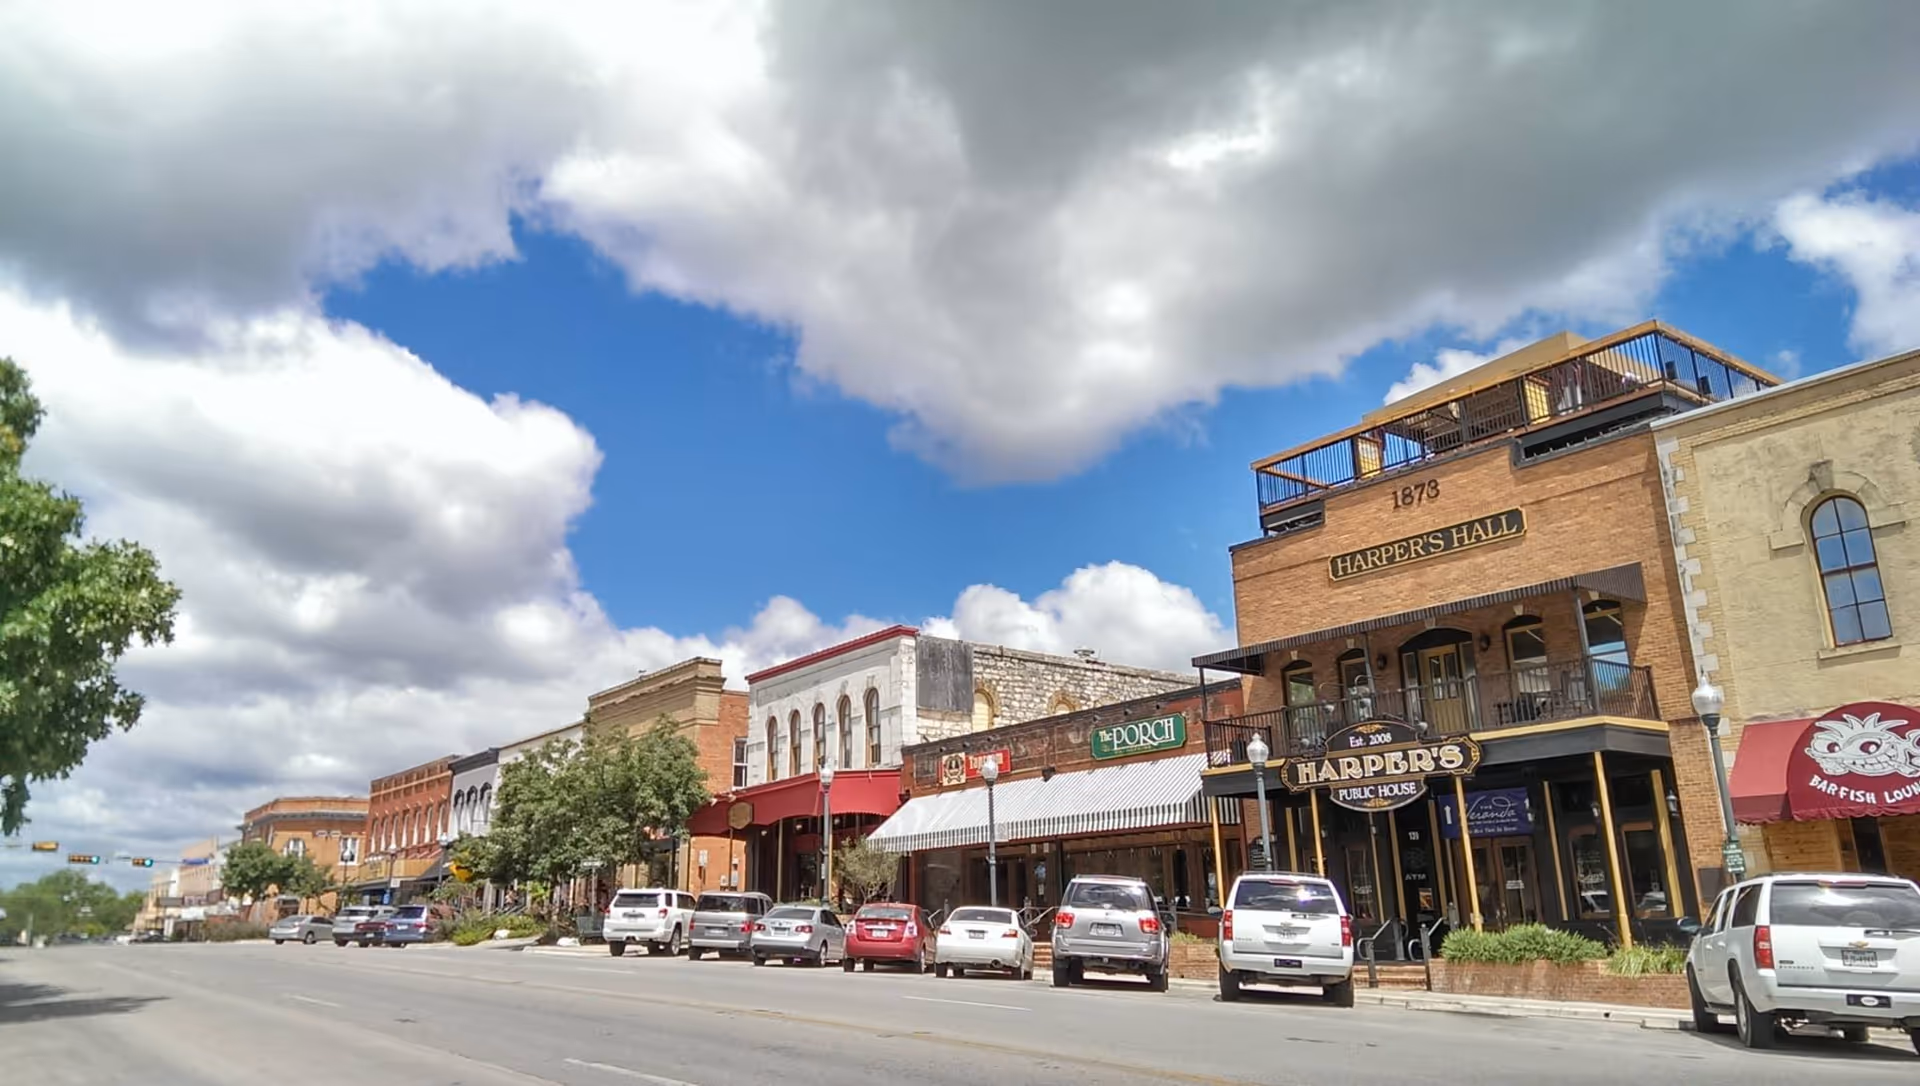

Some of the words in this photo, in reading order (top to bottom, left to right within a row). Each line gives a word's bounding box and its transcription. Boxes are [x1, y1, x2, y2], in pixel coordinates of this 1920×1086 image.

[1335, 532, 1445, 577] HARPER'S
[1451, 514, 1518, 548] HALL
[1098, 729, 1113, 742] The
[1112, 718, 1176, 750] PORCH
[1350, 736, 1367, 748] Est.
[1369, 732, 1392, 745] 2008
[1297, 745, 1464, 784] HARPER'S
[1338, 785, 1375, 801] PUBLIC
[1378, 782, 1417, 799] HOUSE
